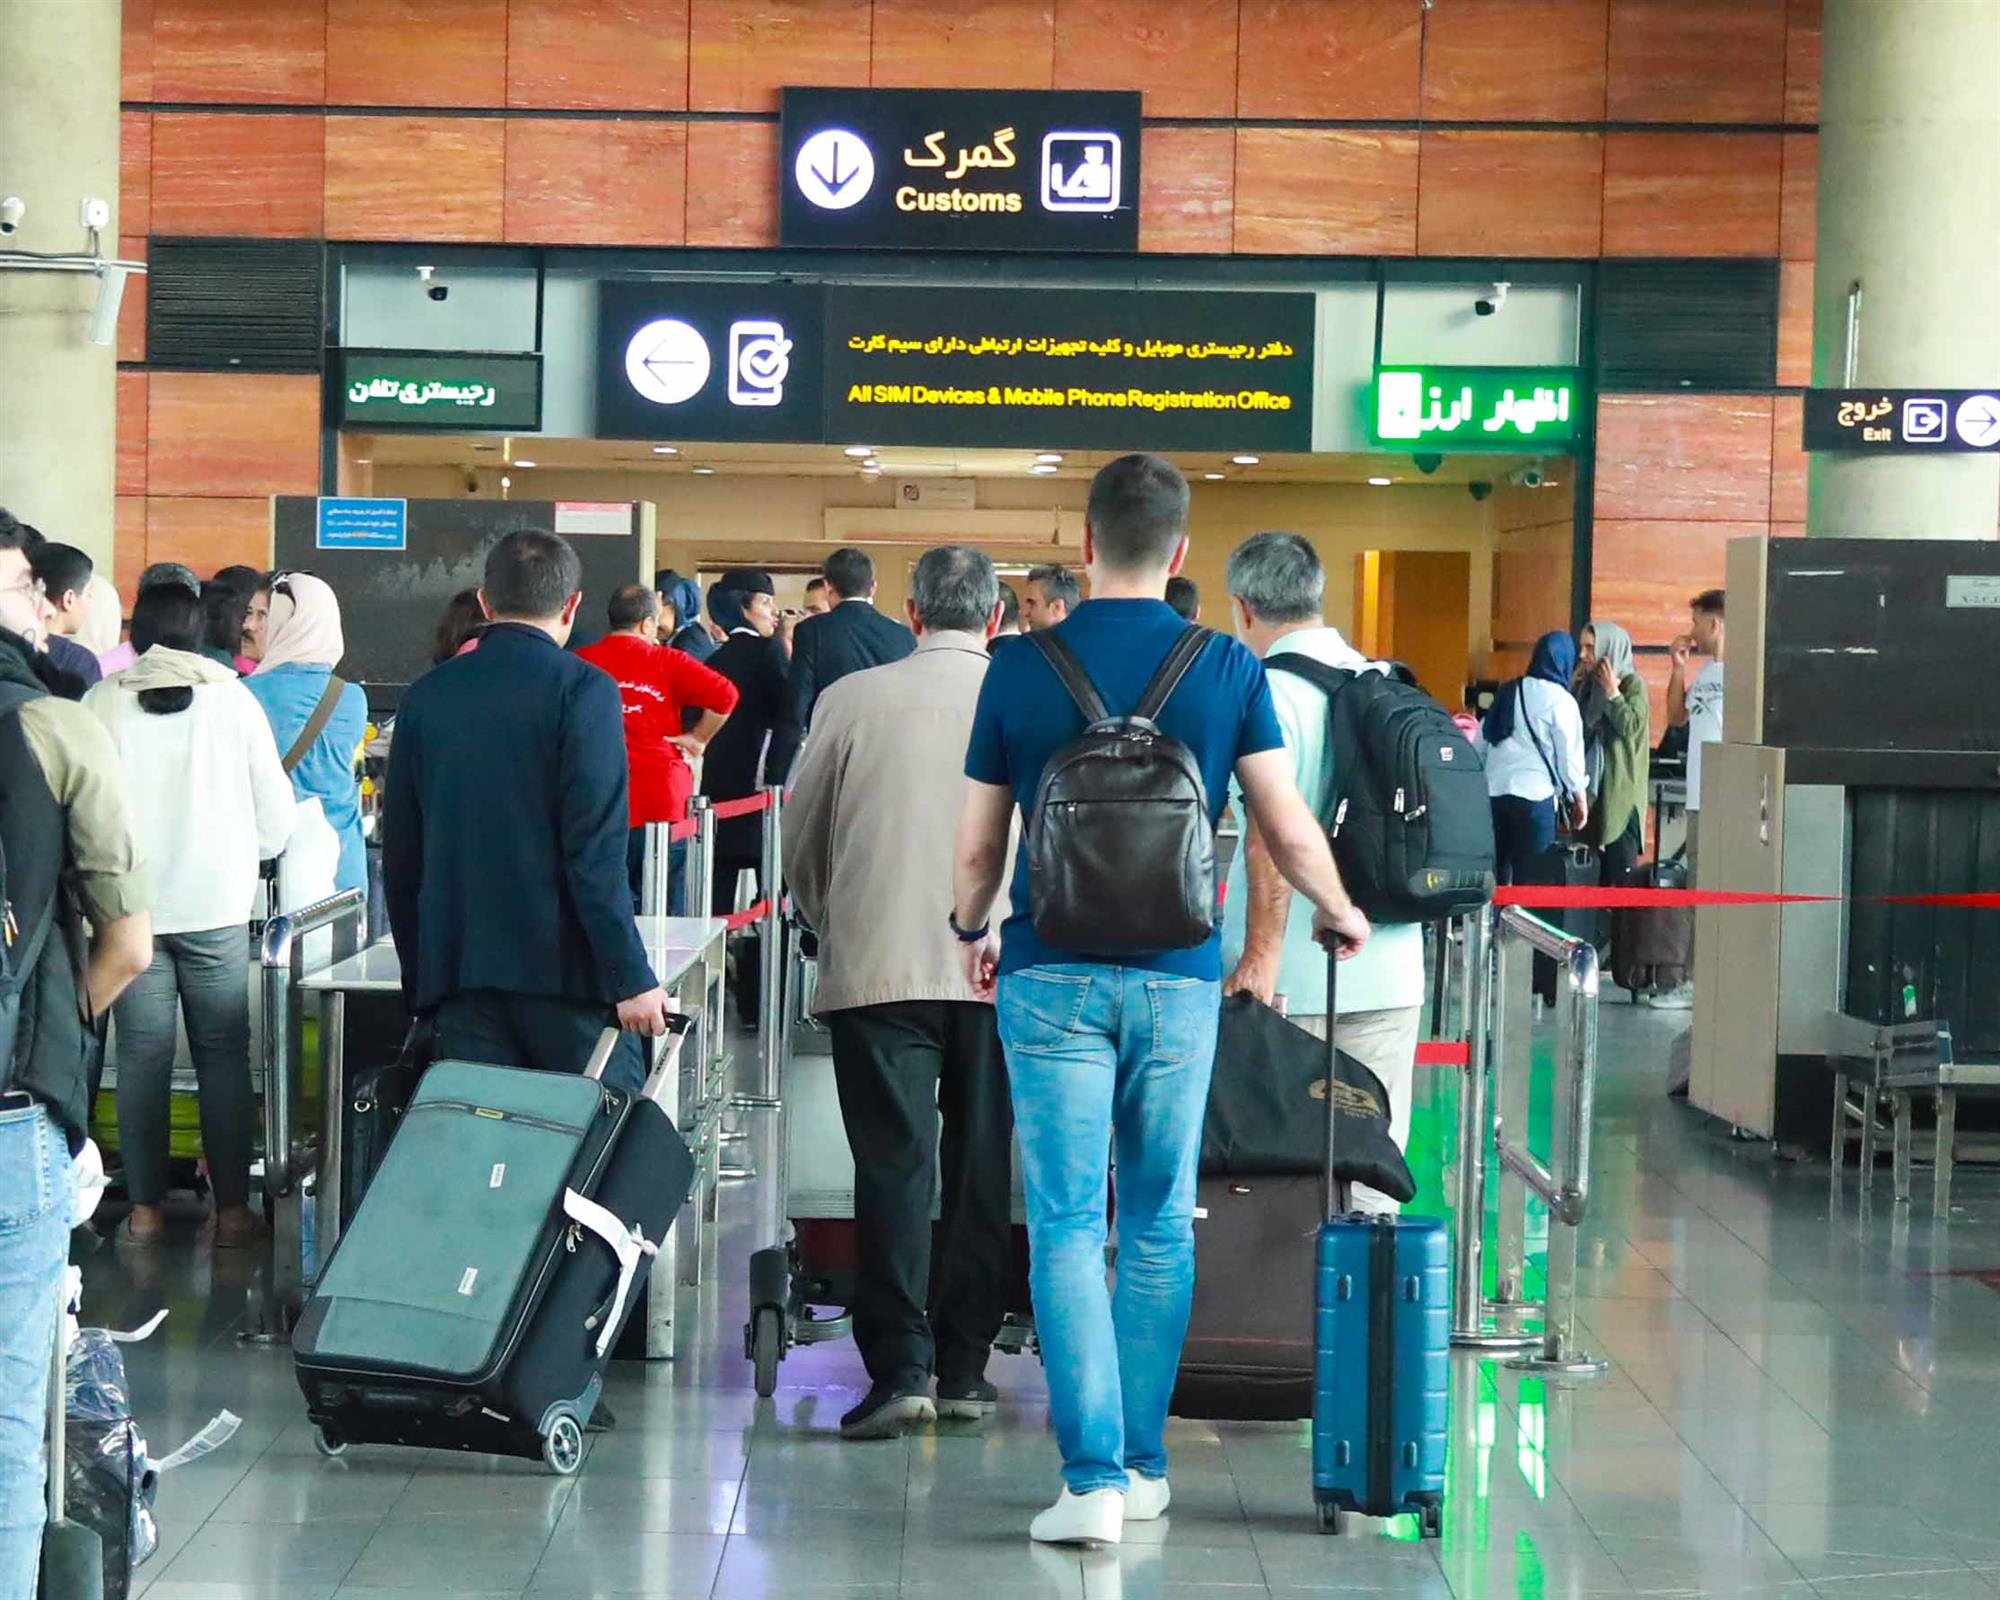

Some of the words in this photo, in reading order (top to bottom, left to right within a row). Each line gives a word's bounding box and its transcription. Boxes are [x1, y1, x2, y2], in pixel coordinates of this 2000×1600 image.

[904, 127, 1016, 179] گمرک
[895, 186, 1022, 213] Customs
[848, 334, 886, 353] کارت
[887, 339, 923, 354] سیم
[923, 336, 967, 355] دارای
[968, 336, 1023, 356] ارتباطی
[1025, 337, 1087, 357] تجهیزات
[1088, 338, 1122, 357] کلیه
[1123, 343, 1134, 357] و
[1135, 339, 1184, 358] موبایل
[1186, 342, 1256, 360] رجیستری
[1257, 341, 1293, 360] دفتر
[349, 379, 401, 403] تلفن
[399, 382, 496, 407] رجیستری
[848, 385, 872, 403] All
[873, 385, 911, 403] SIM
[912, 386, 985, 404] Devices
[986, 386, 1002, 405] &
[1003, 387, 1065, 406] Mobile
[1067, 388, 1127, 407] Phone
[1127, 389, 1237, 412] Registration
[1237, 391, 1292, 410] Office
[1420, 386, 1473, 432] ارز
[1483, 387, 1570, 434] اظهار
[1837, 396, 1893, 427] خروج
[1863, 427, 1892, 442] Exit
